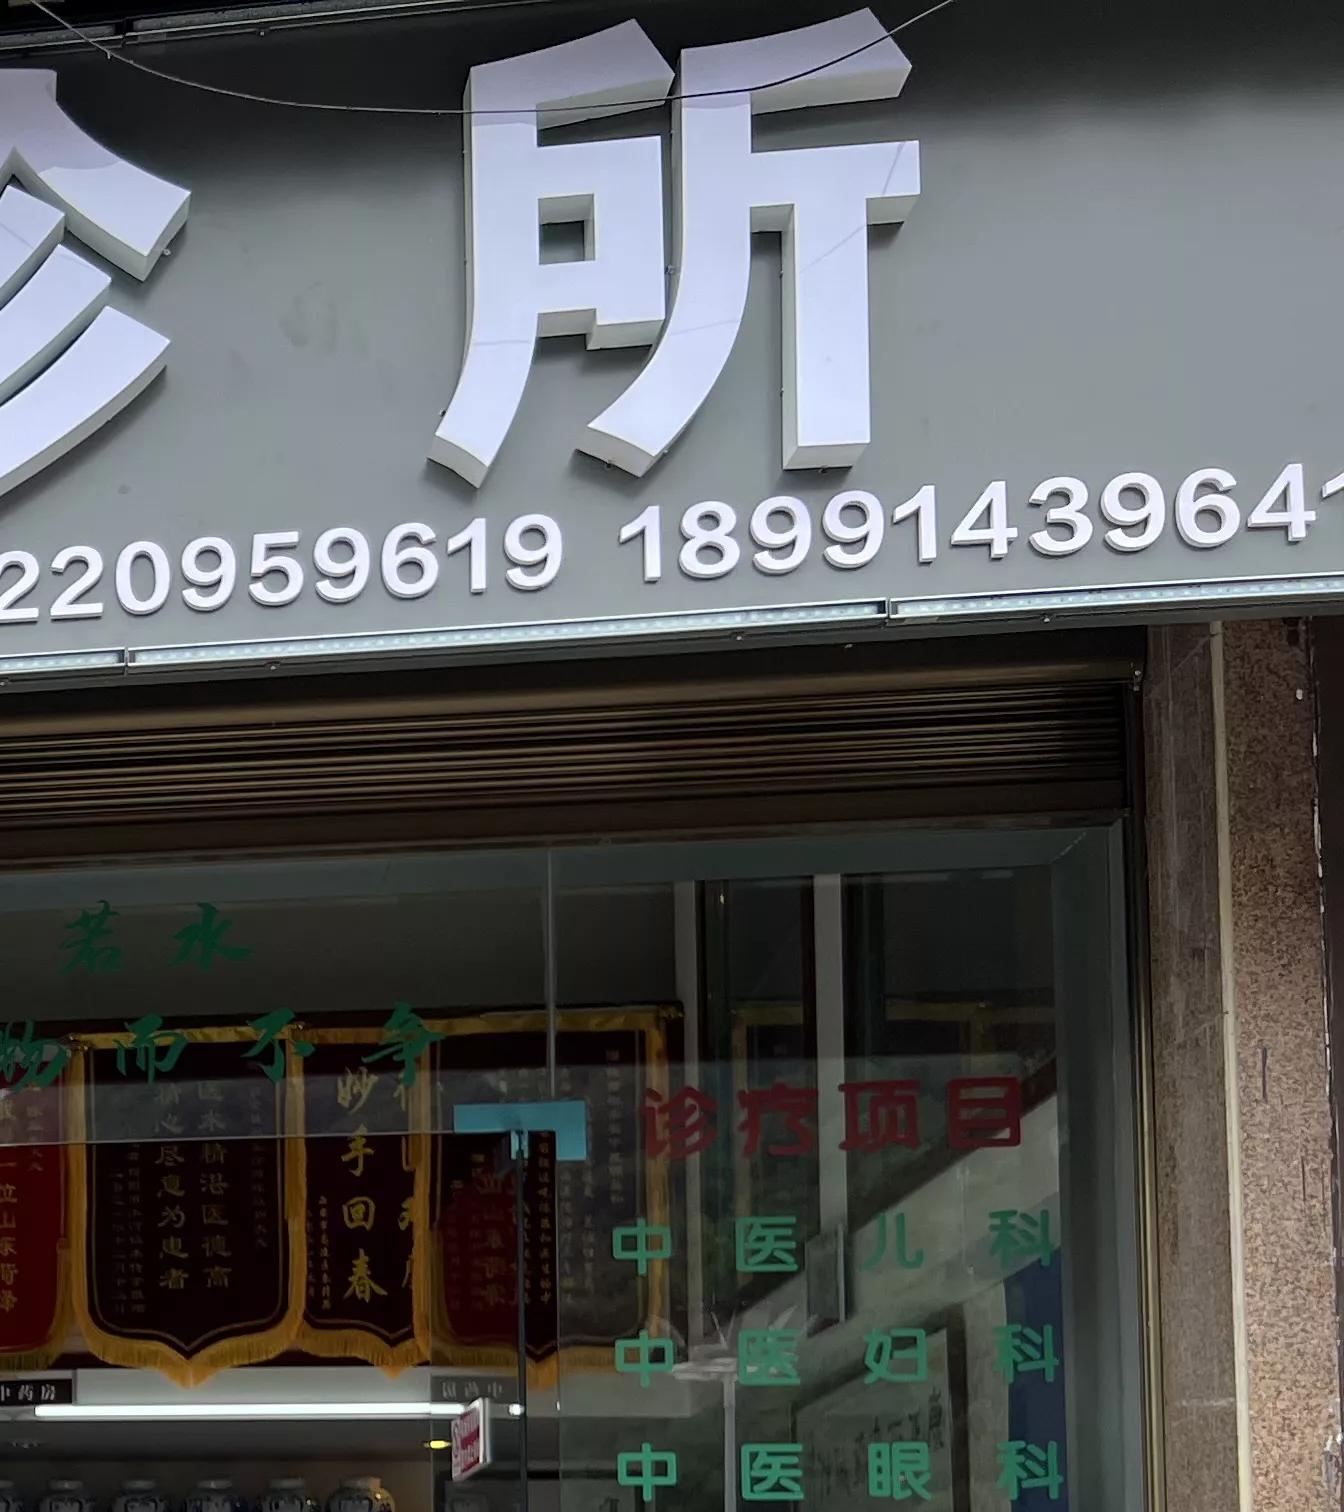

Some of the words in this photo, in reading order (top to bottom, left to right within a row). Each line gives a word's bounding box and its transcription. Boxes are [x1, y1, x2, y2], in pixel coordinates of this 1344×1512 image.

[619, 462, 1344, 590] 1899143964
[640, 1076, 1023, 1161] 诊疗项目
[337, 1065, 388, 1304] 妙手回春
[612, 1208, 1061, 1276] 中医儿科
[614, 1325, 1060, 1387] 中医妇科
[617, 1439, 1064, 1502] 中医眼科
